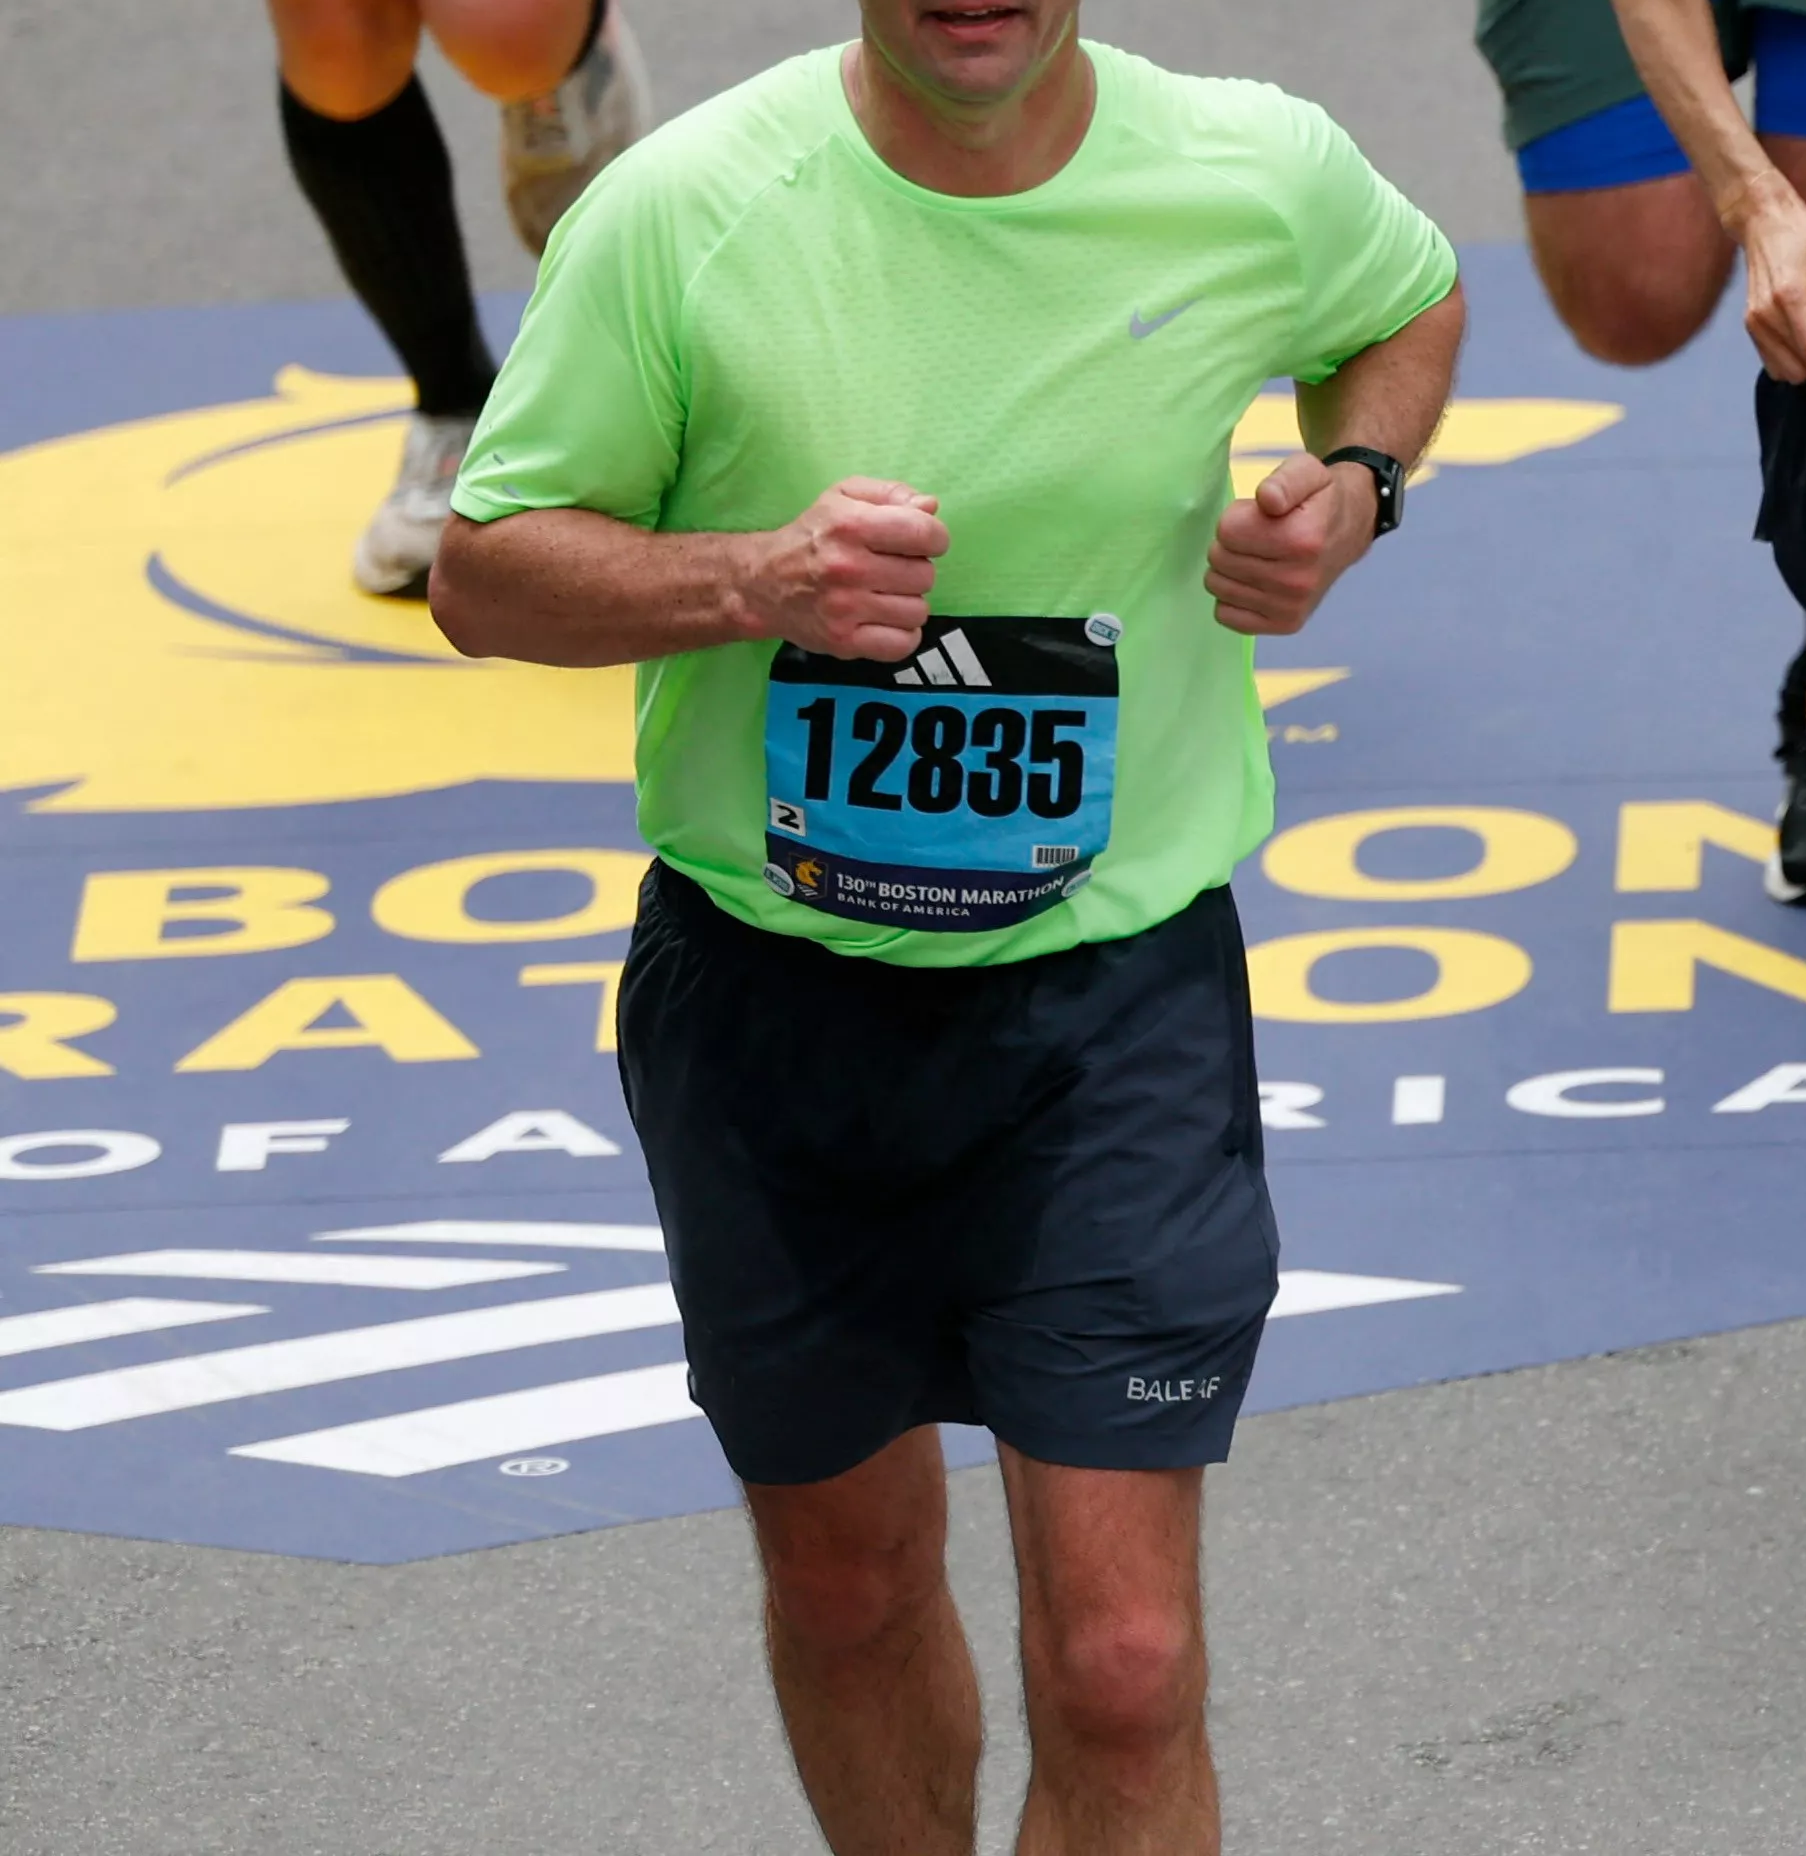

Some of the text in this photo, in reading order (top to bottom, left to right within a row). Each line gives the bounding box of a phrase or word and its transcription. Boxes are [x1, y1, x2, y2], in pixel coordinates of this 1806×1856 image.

[796, 697, 1087, 820] 12835
[775, 803, 801, 831] 2
[836, 873, 877, 893] 130TH
[878, 882, 956, 904] BOSTON
[961, 875, 1065, 905] MARATHON
[837, 892, 971, 917] BANK OF AMERICA
[0, 1117, 351, 1181] OF
